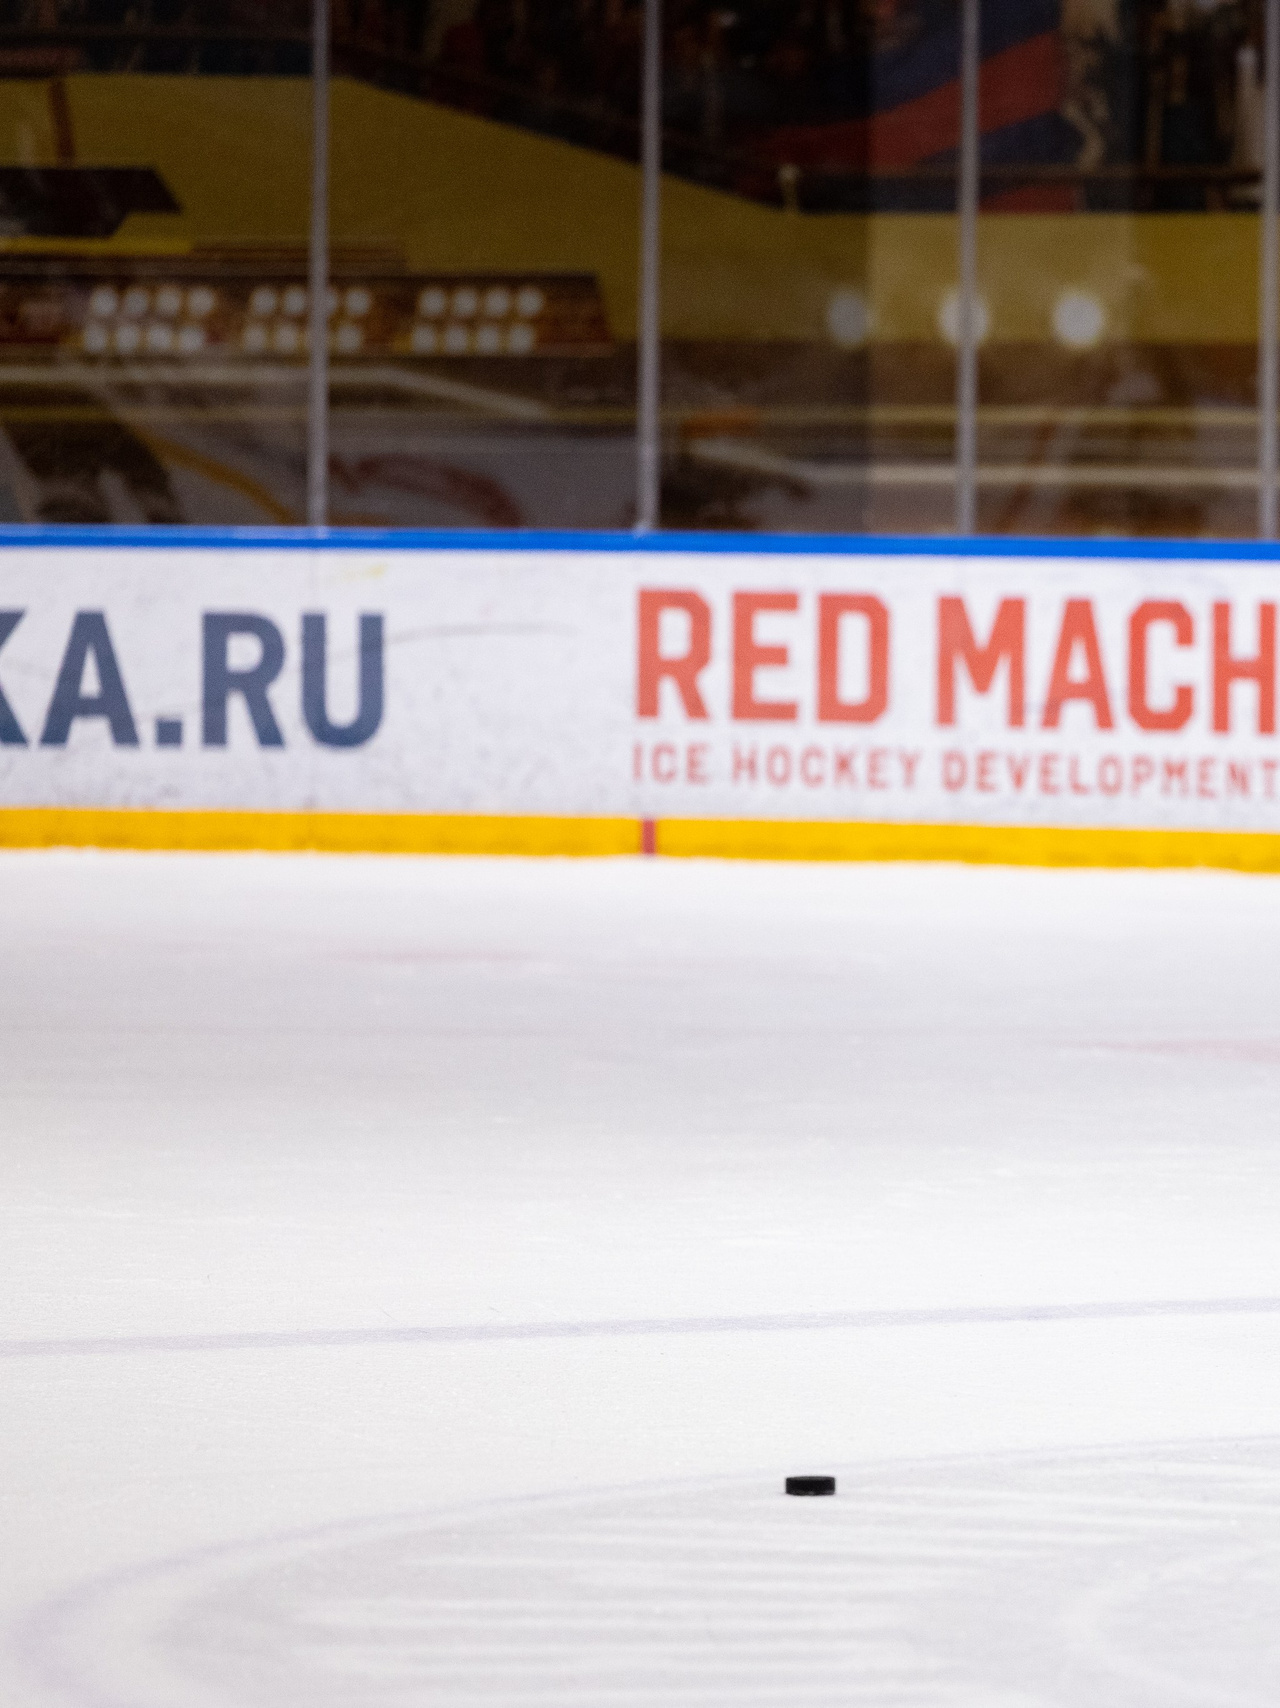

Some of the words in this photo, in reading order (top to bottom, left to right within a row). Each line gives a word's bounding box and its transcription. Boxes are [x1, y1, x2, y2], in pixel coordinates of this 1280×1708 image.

[636, 588, 889, 723] RED
[633, 743, 709, 785] ICE
[732, 744, 921, 790] HOCKEY
